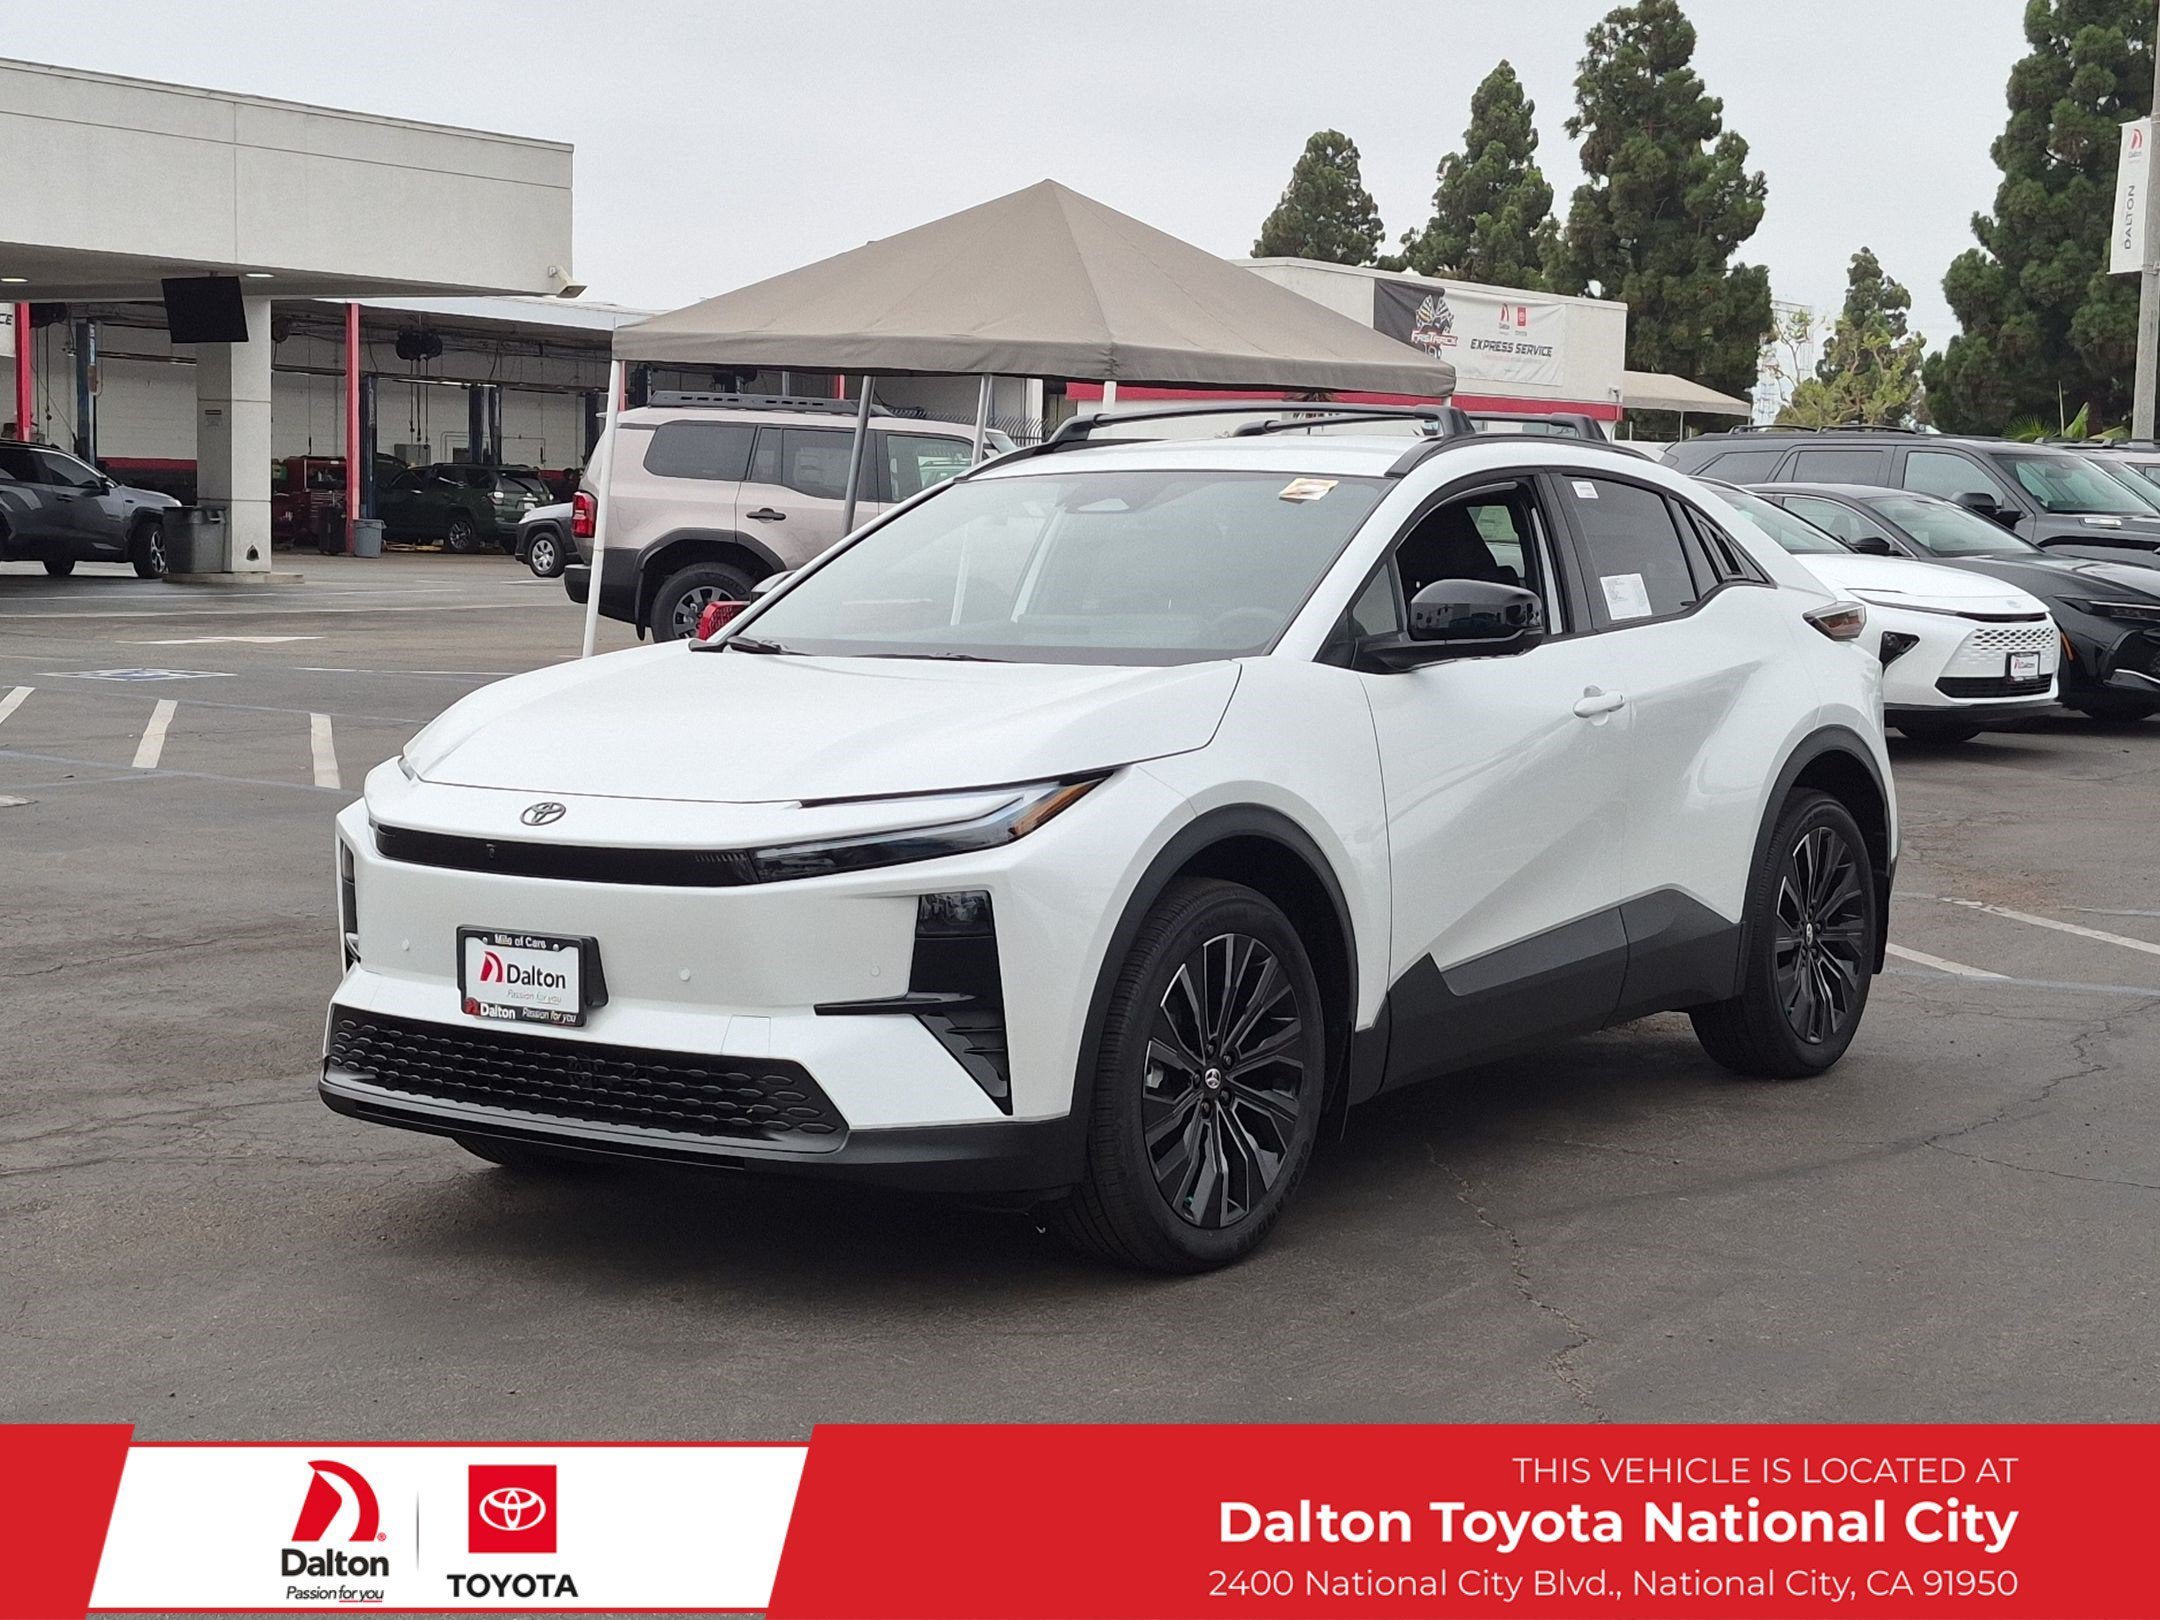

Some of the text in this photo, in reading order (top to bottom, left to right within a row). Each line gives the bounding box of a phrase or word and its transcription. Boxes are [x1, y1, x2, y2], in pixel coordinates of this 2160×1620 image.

[2123, 185, 2136, 250] DALTON
[1470, 338, 1554, 358] EXPRESS SERVICE
[494, 933, 547, 950] Mile of Cars
[506, 963, 566, 989] Dalton
[506, 989, 535, 1001] Passion
[480, 1002, 577, 1024] Dalton Passion for you
